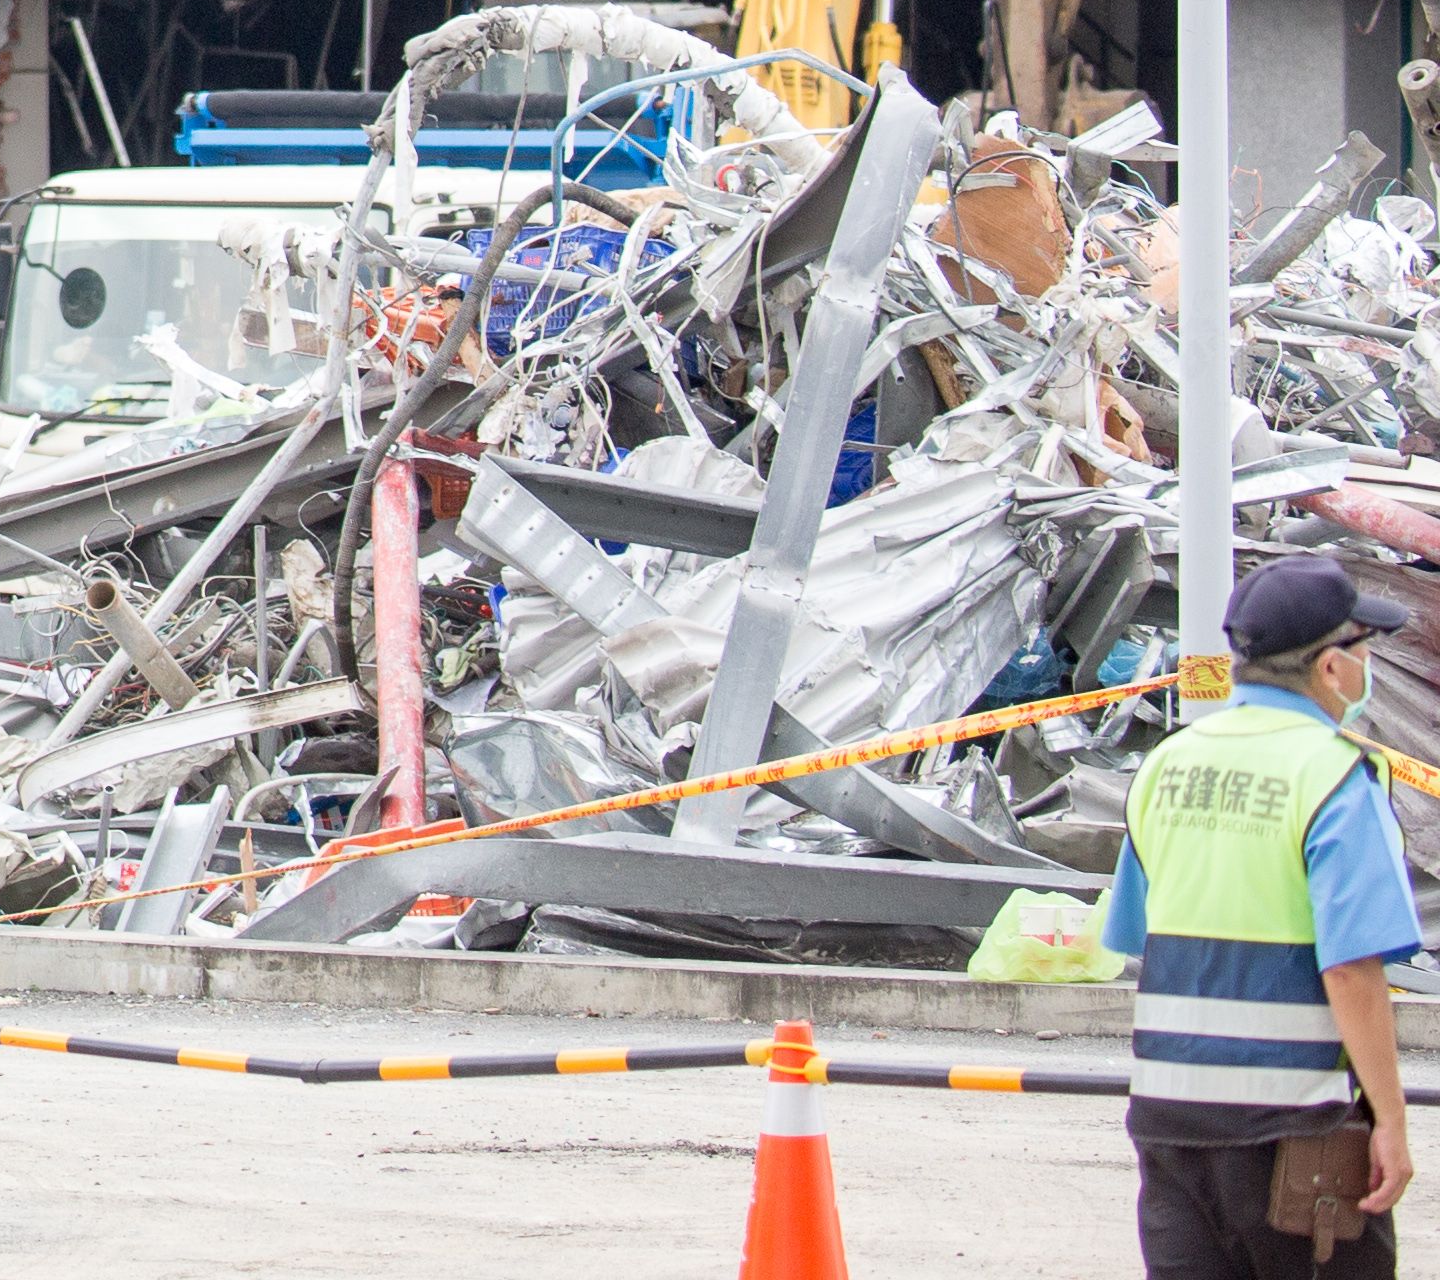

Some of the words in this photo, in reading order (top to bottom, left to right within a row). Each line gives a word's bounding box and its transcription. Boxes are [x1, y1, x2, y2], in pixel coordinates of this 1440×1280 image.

[1155, 765, 1290, 822] 先鋒保全
[1220, 819, 1282, 839] SECURITY
